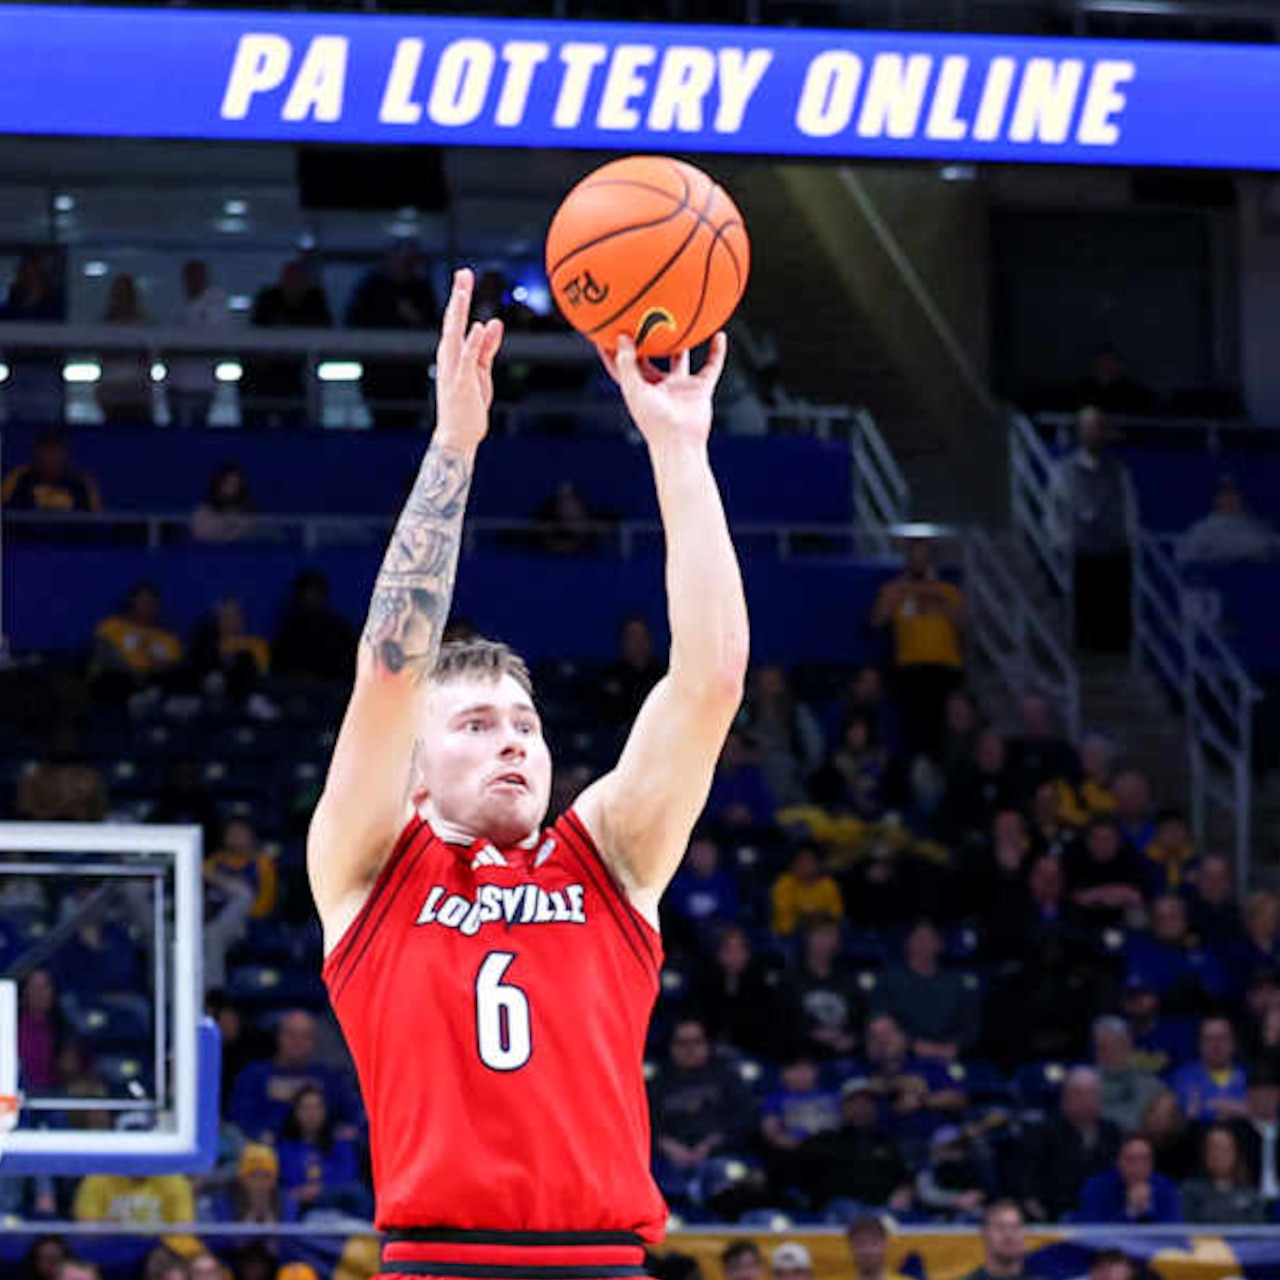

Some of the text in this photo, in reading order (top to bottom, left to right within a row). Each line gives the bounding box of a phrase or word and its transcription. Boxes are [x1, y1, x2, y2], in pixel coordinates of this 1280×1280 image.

[220, 33, 1136, 147] PA LOTTERY ONLINE
[475, 950, 533, 1072] 6
